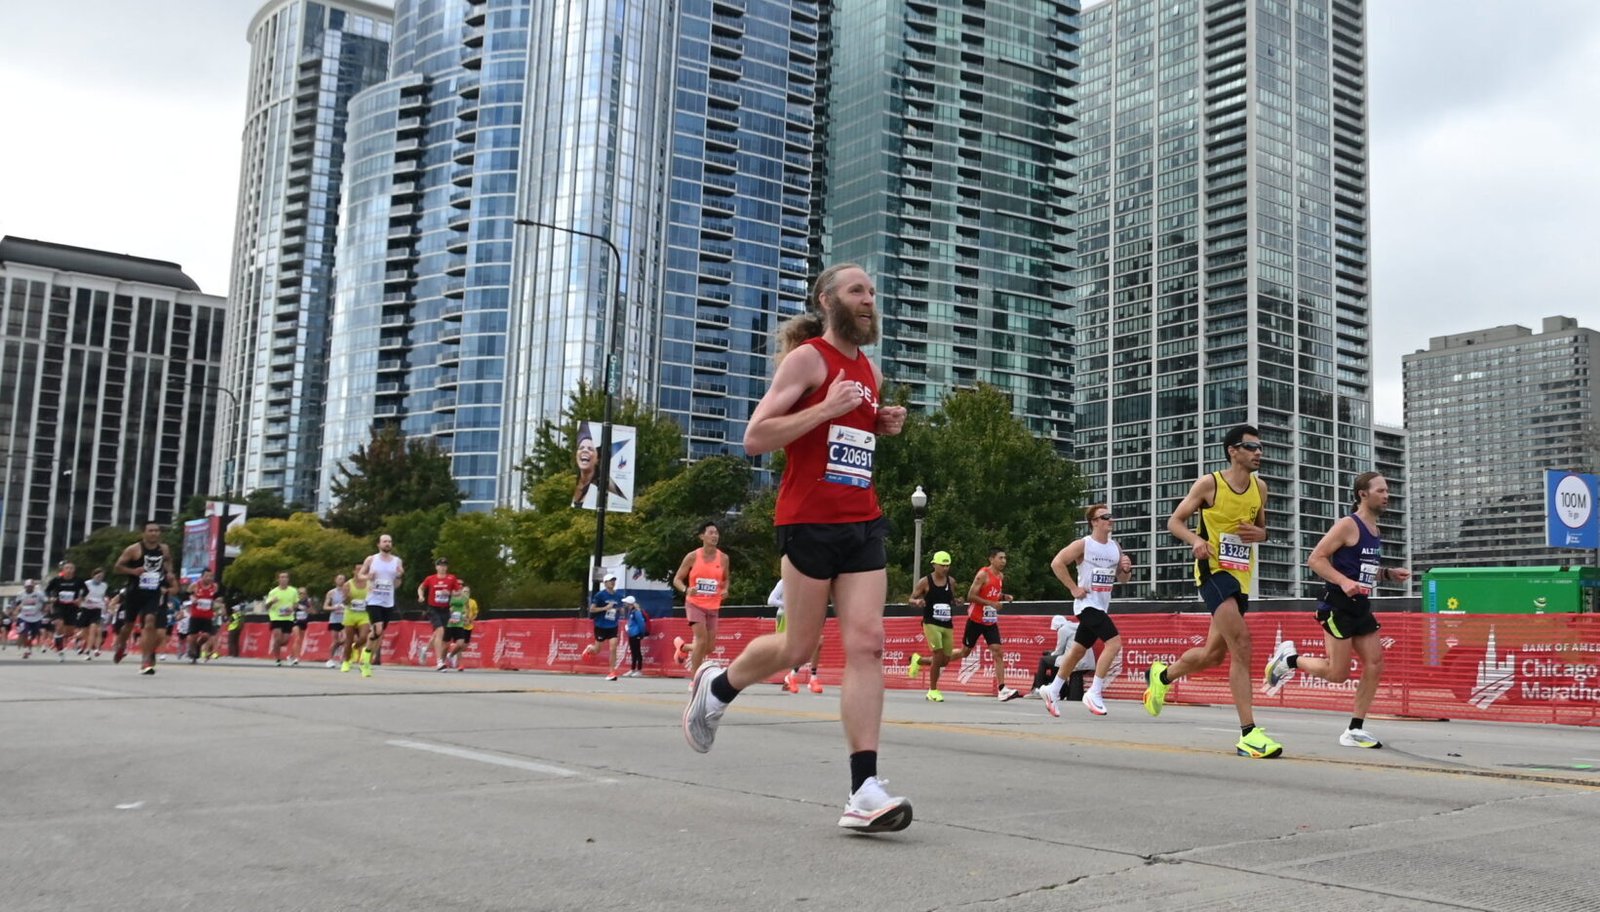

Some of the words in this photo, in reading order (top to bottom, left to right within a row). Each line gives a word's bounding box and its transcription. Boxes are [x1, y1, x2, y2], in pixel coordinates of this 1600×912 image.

[829, 445, 839, 460] C
[841, 447, 872, 467] 20691
[1561, 492, 1586, 508] 100M
[1220, 543, 1226, 555] B
[1228, 544, 1249, 558] 3284
[1522, 643, 1551, 652] BANK
[1554, 643, 1570, 651] OF
[1127, 650, 1176, 665] Chicago
[1522, 659, 1598, 681] Chicago
